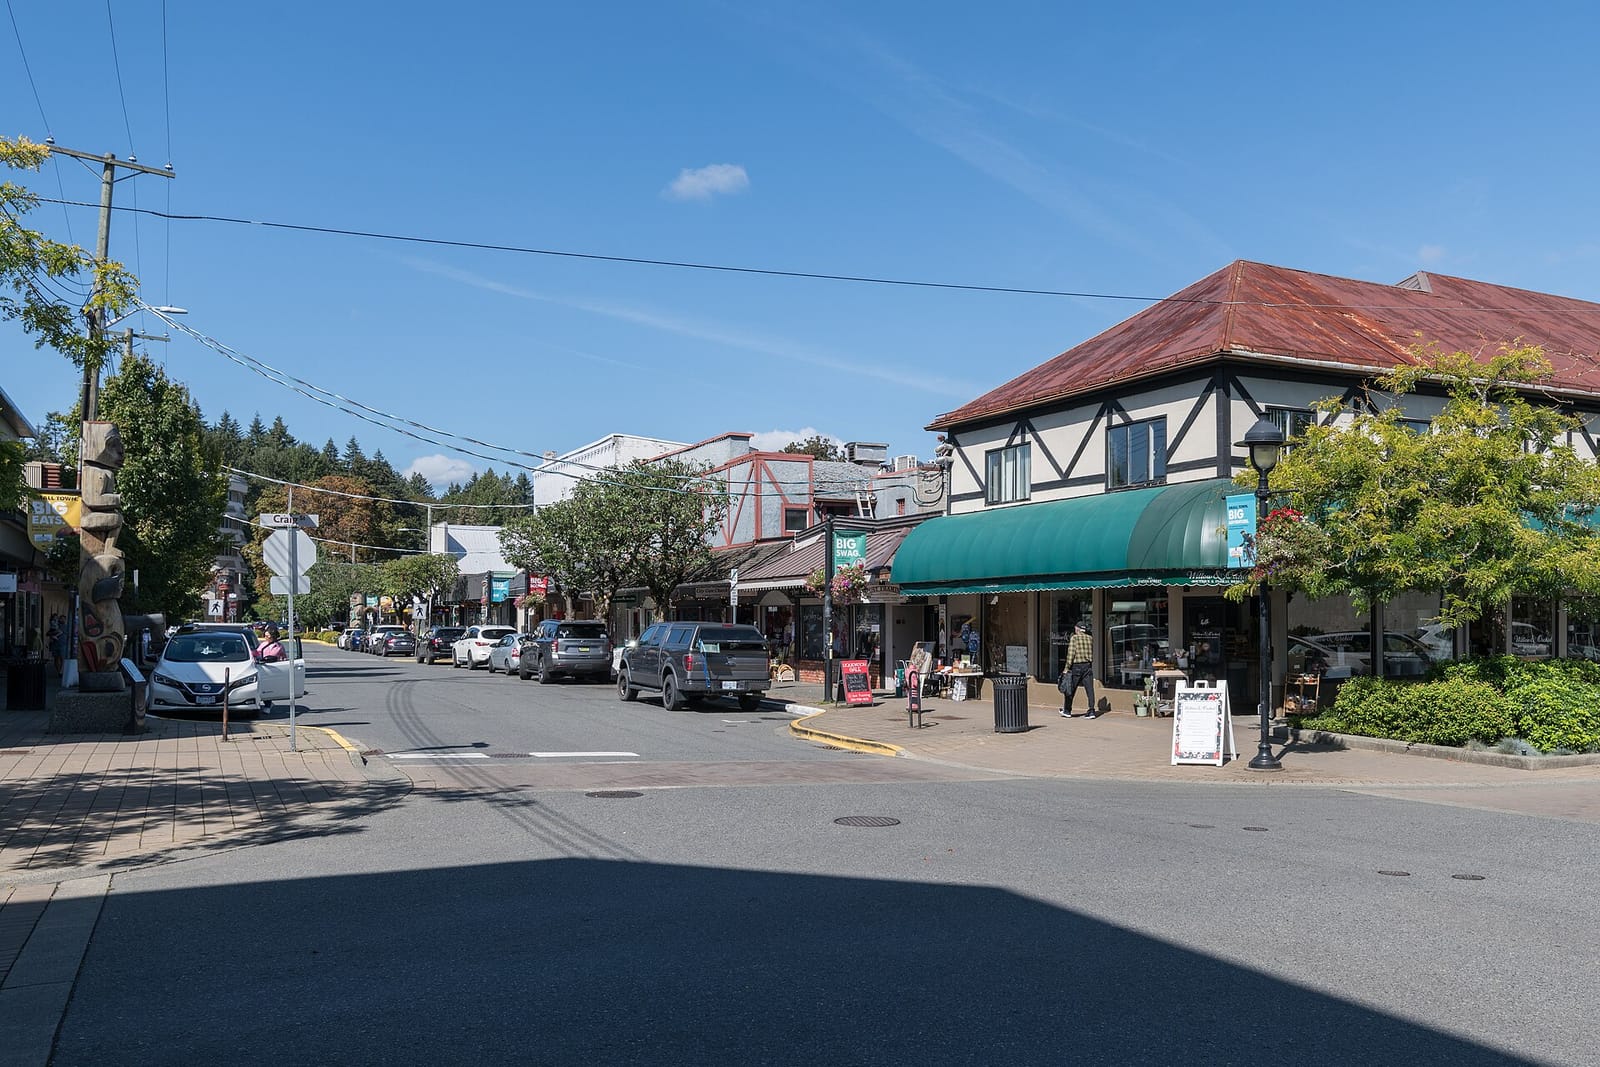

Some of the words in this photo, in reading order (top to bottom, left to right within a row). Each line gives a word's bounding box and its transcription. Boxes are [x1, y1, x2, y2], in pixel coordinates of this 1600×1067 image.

[32, 501, 68, 515] BIG
[32, 515, 66, 525] EATS.
[1228, 509, 1244, 520] BIG
[836, 538, 857, 550] BIG
